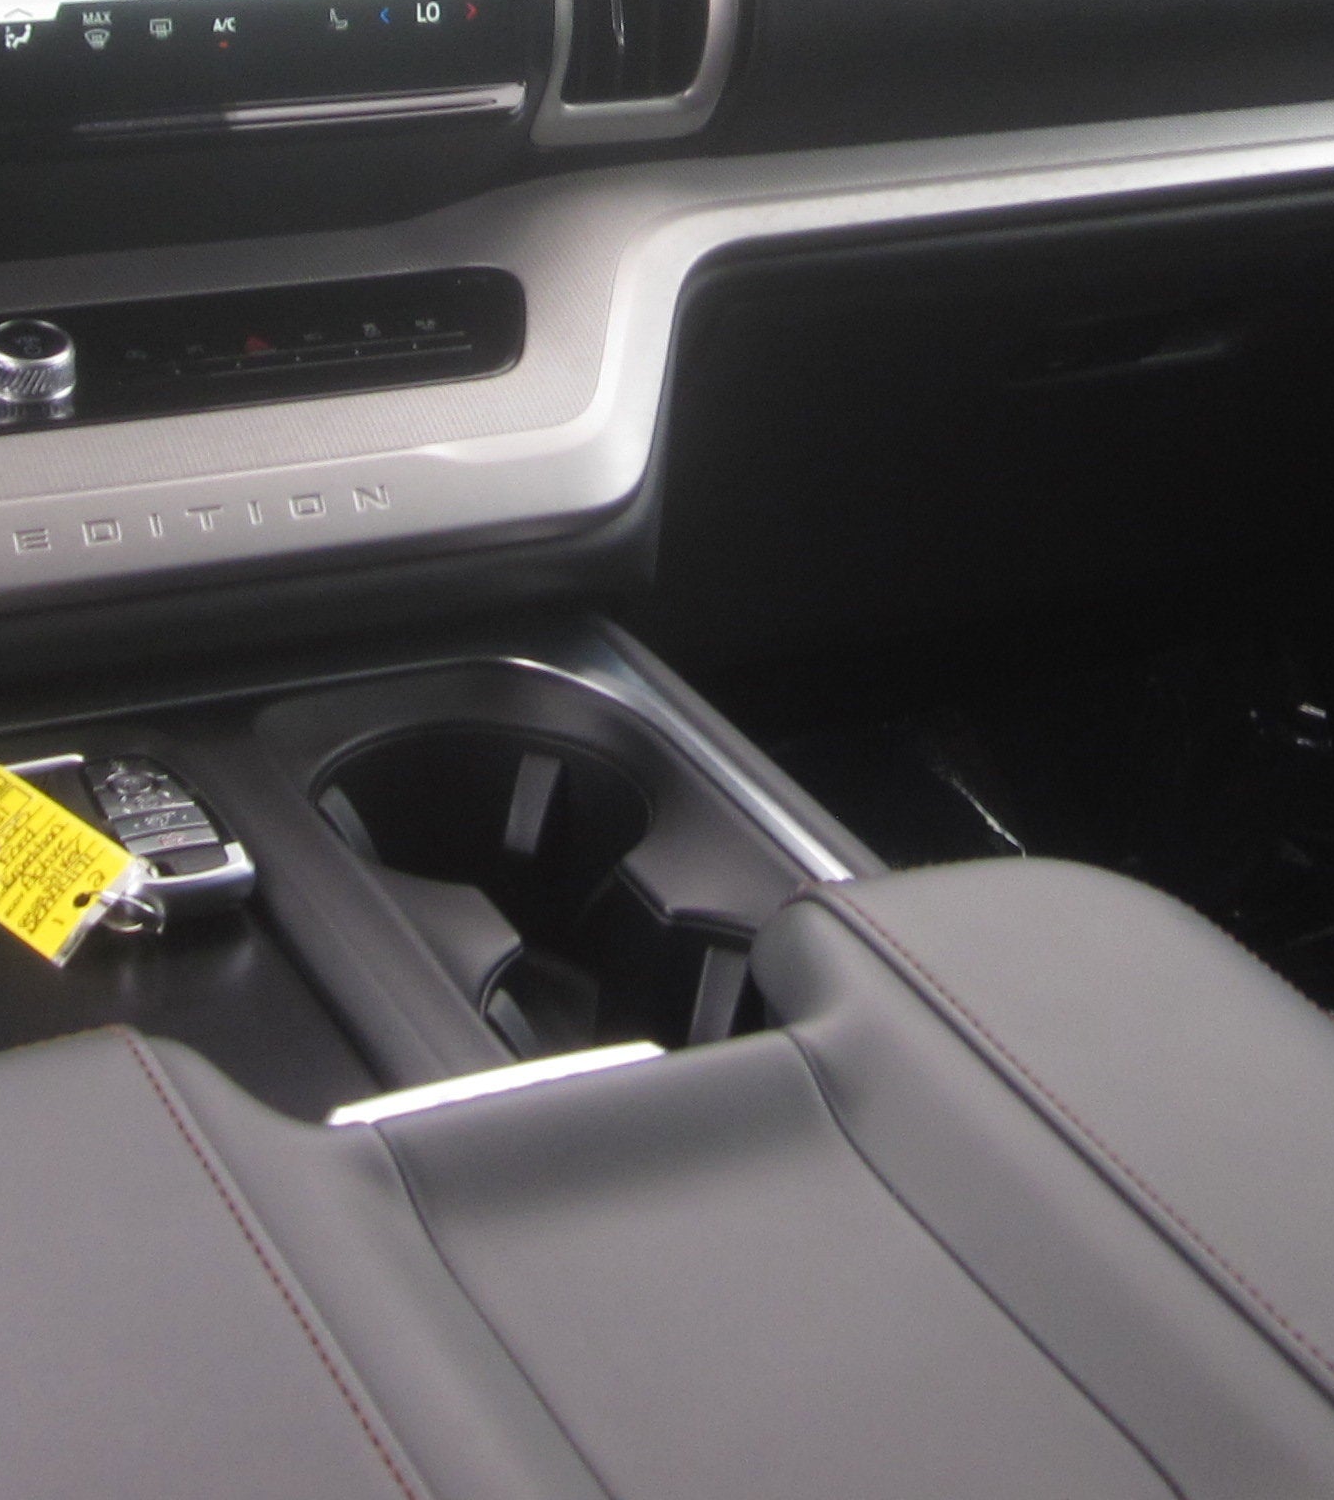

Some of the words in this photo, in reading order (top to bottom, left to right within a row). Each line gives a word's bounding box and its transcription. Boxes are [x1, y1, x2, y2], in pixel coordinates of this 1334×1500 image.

[82, 11, 112, 26] MAX
[416, 2, 441, 24] LO
[213, 16, 236, 34] A/C
